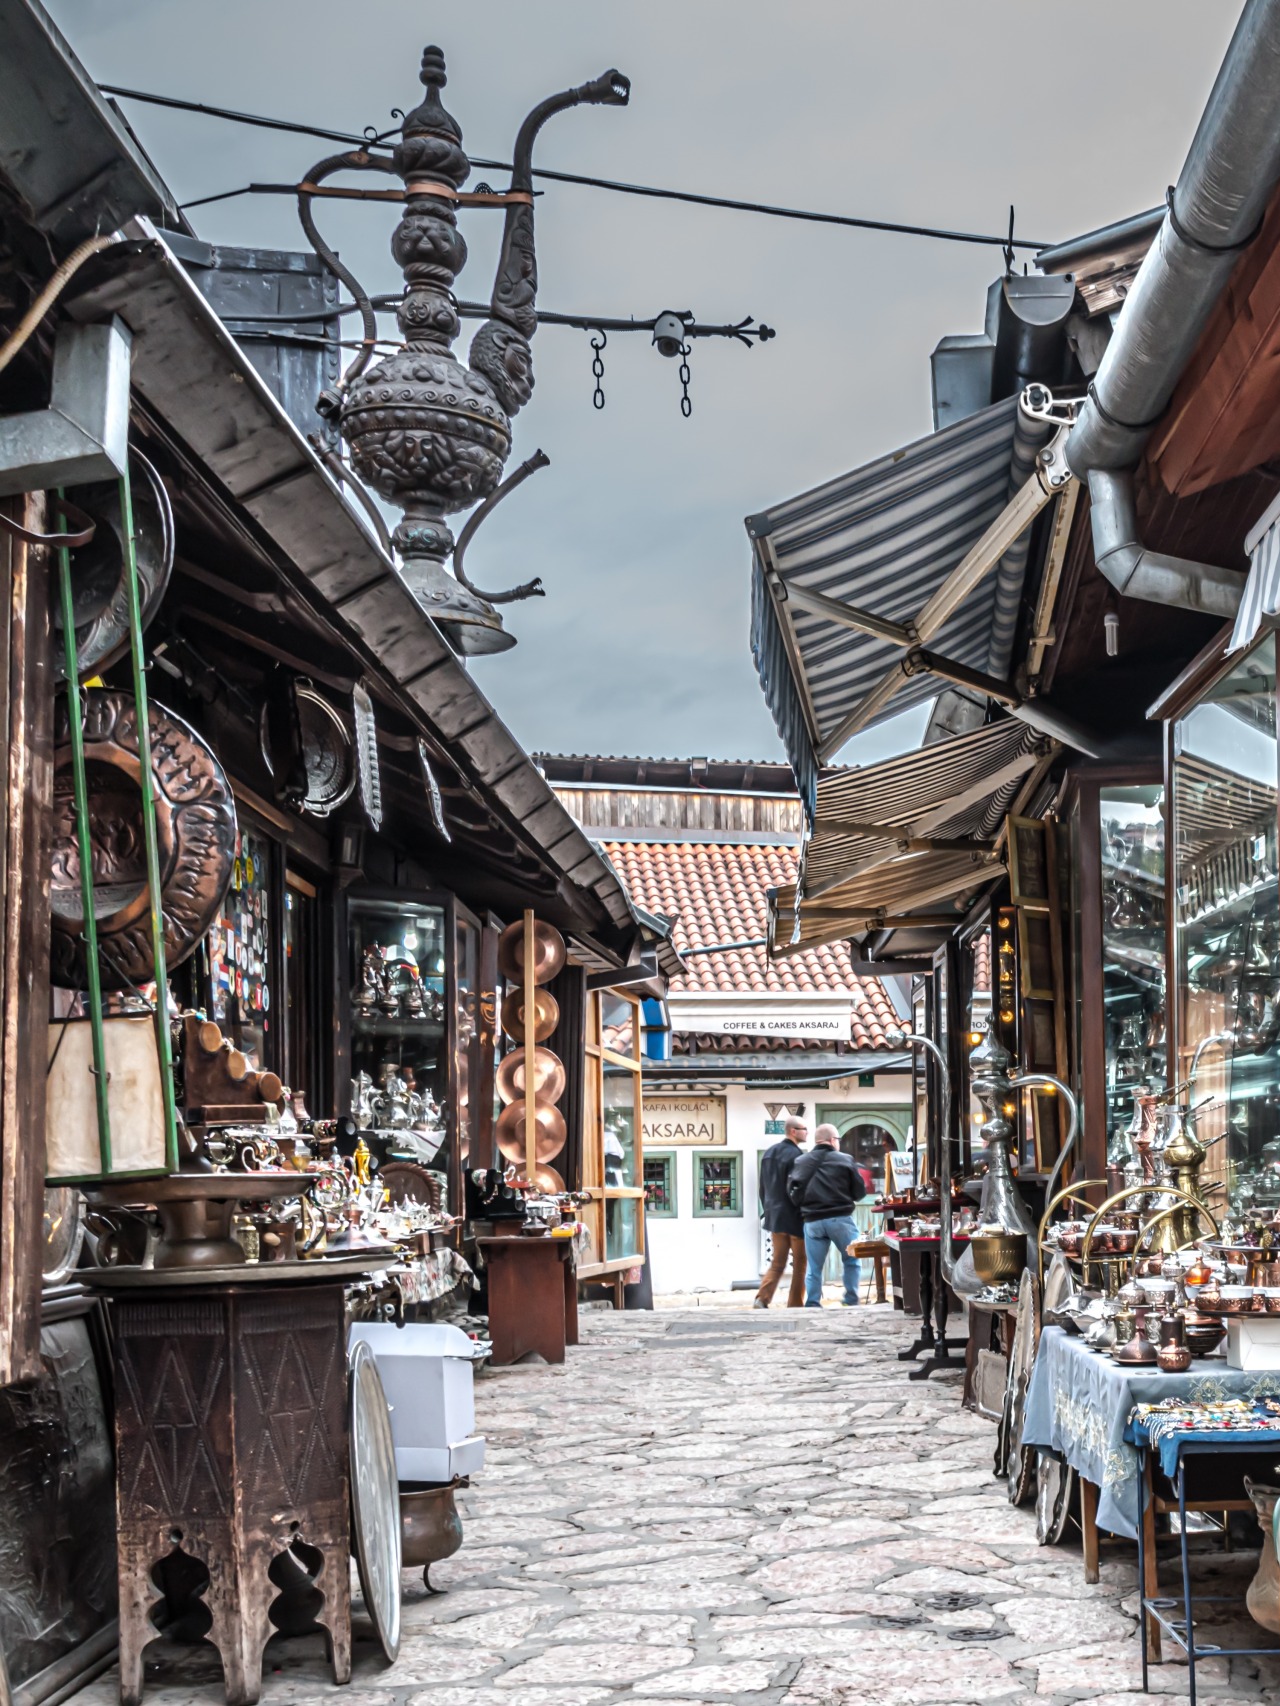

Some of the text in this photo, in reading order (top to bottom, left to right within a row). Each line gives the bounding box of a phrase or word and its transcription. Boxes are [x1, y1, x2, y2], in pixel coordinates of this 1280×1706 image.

[723, 1022, 757, 1030] COFFEE
[799, 1021, 839, 1029] AKSARAJ
[642, 1104, 667, 1112] KAFA
[642, 1123, 714, 1141] AKSARAJ
